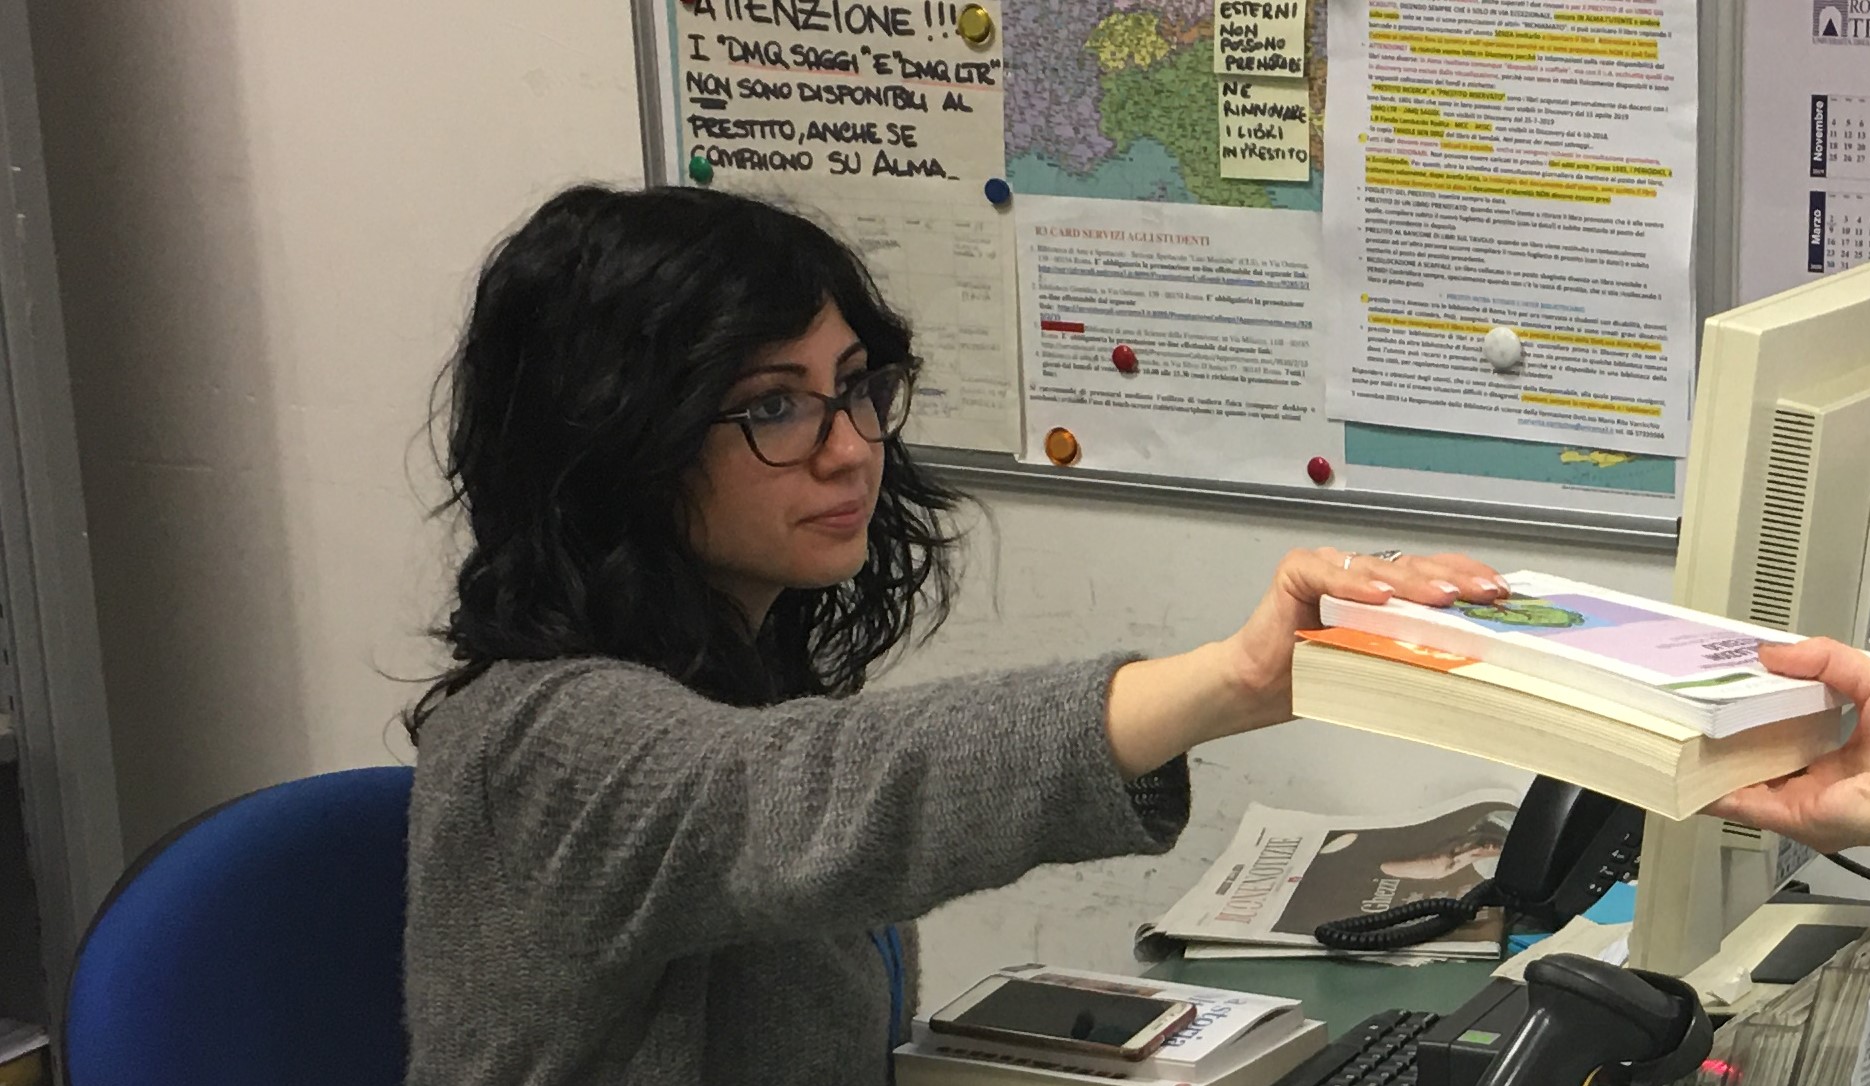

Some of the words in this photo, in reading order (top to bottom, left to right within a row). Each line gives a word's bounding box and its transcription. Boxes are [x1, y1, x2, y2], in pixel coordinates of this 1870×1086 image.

[1220, 2, 1298, 19] ESTERNI
[1220, 21, 1258, 38] NON
[688, 34, 710, 61] I
[686, 71, 732, 99] NON
[736, 76, 792, 100] SONO
[942, 92, 973, 112] AL
[1222, 81, 1252, 99] NE
[806, 121, 882, 144] ANCHE
[887, 123, 918, 148] SE
[1238, 123, 1283, 140] LIBRI
[1813, 100, 1825, 162] Novembre
[1241, 143, 1307, 163] PRESTITO
[828, 153, 862, 174] SU
[1050, 226, 1080, 238] CARD
[1810, 209, 1822, 246] Marzo
